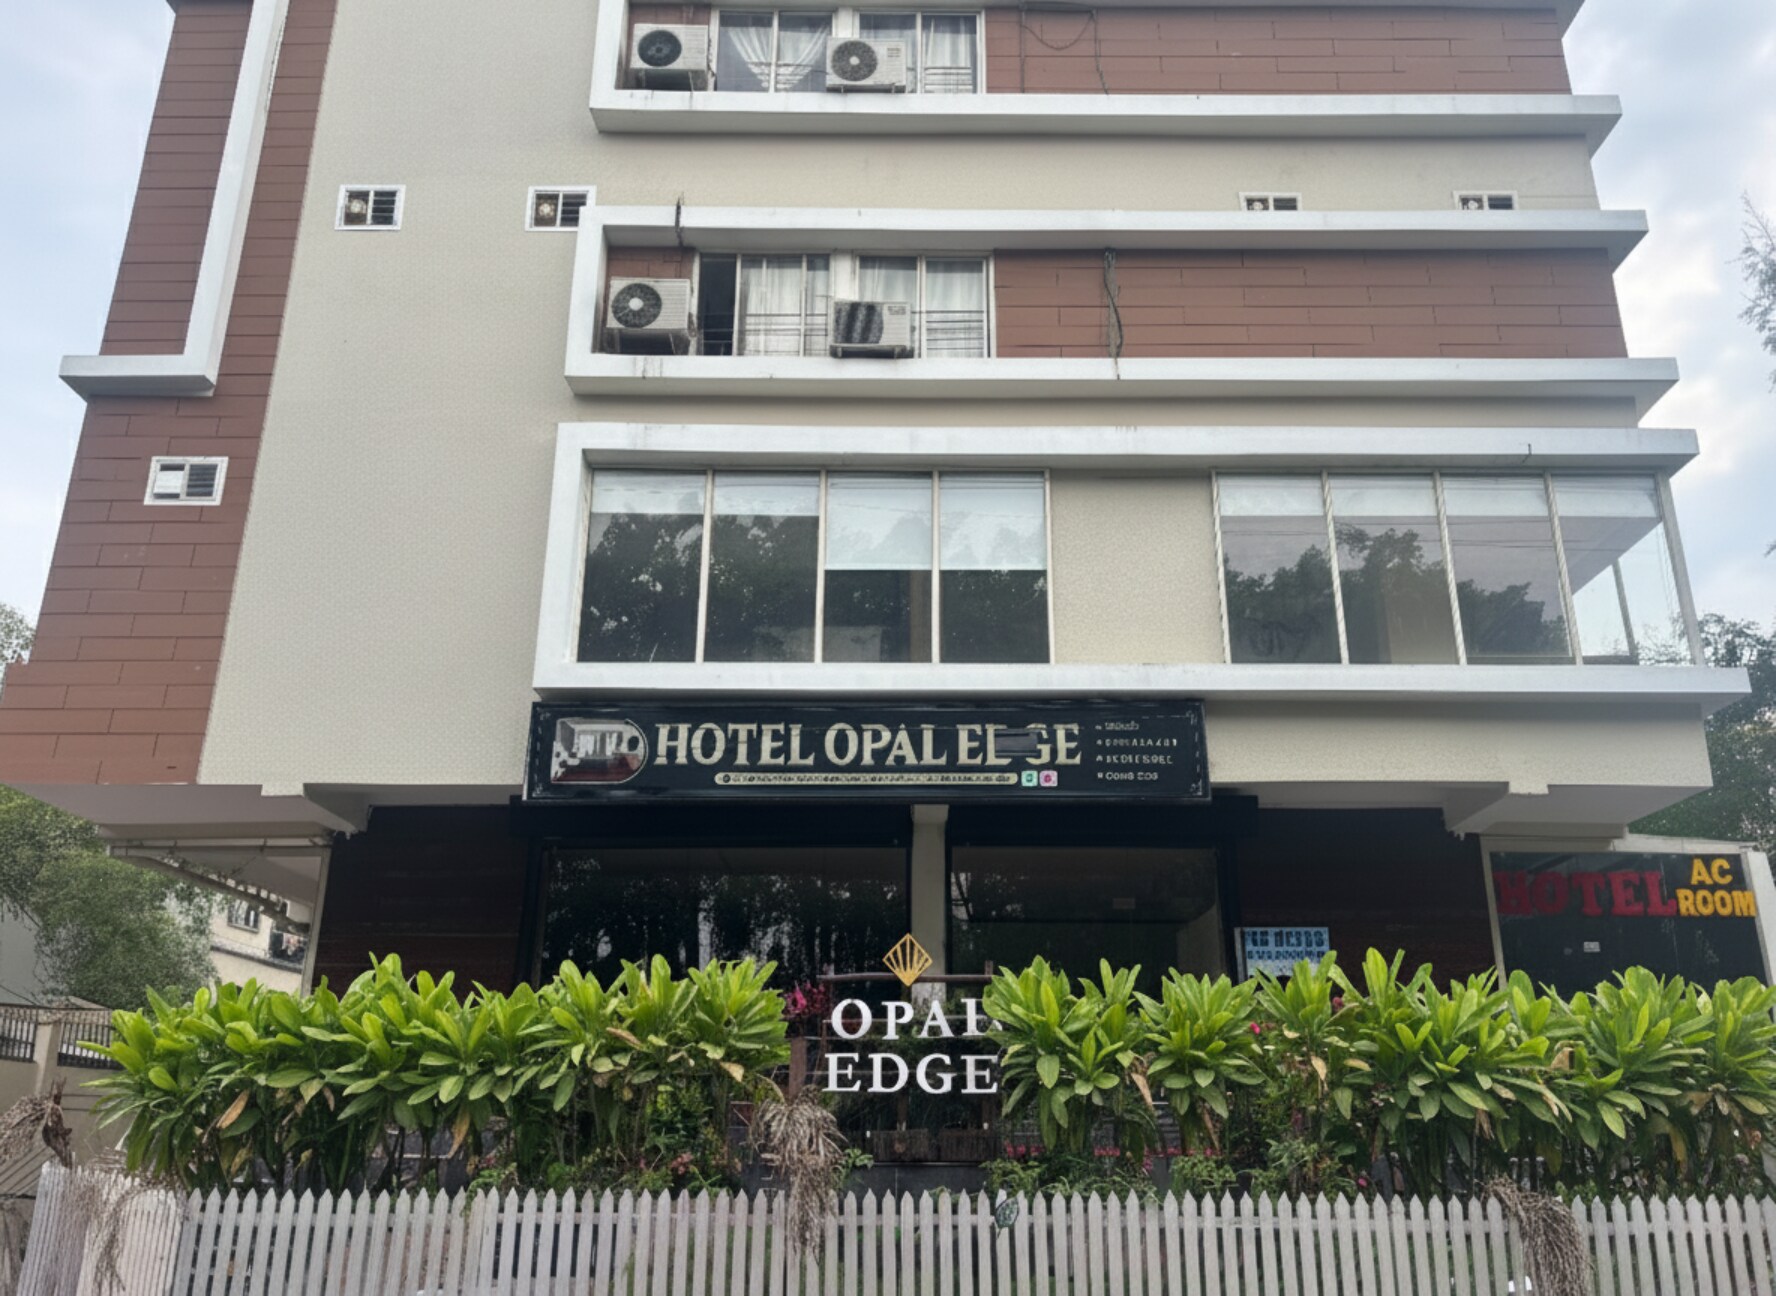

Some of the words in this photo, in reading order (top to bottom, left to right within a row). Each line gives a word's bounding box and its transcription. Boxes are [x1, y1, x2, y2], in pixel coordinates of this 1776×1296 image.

[653, 722, 815, 766] HOTEL
[824, 722, 948, 766] OPAL
[1691, 858, 1733, 885] AC
[1493, 870, 1678, 918] HOTEL
[1676, 888, 1757, 917] ROOM
[822, 1052, 998, 1094] EDGE
